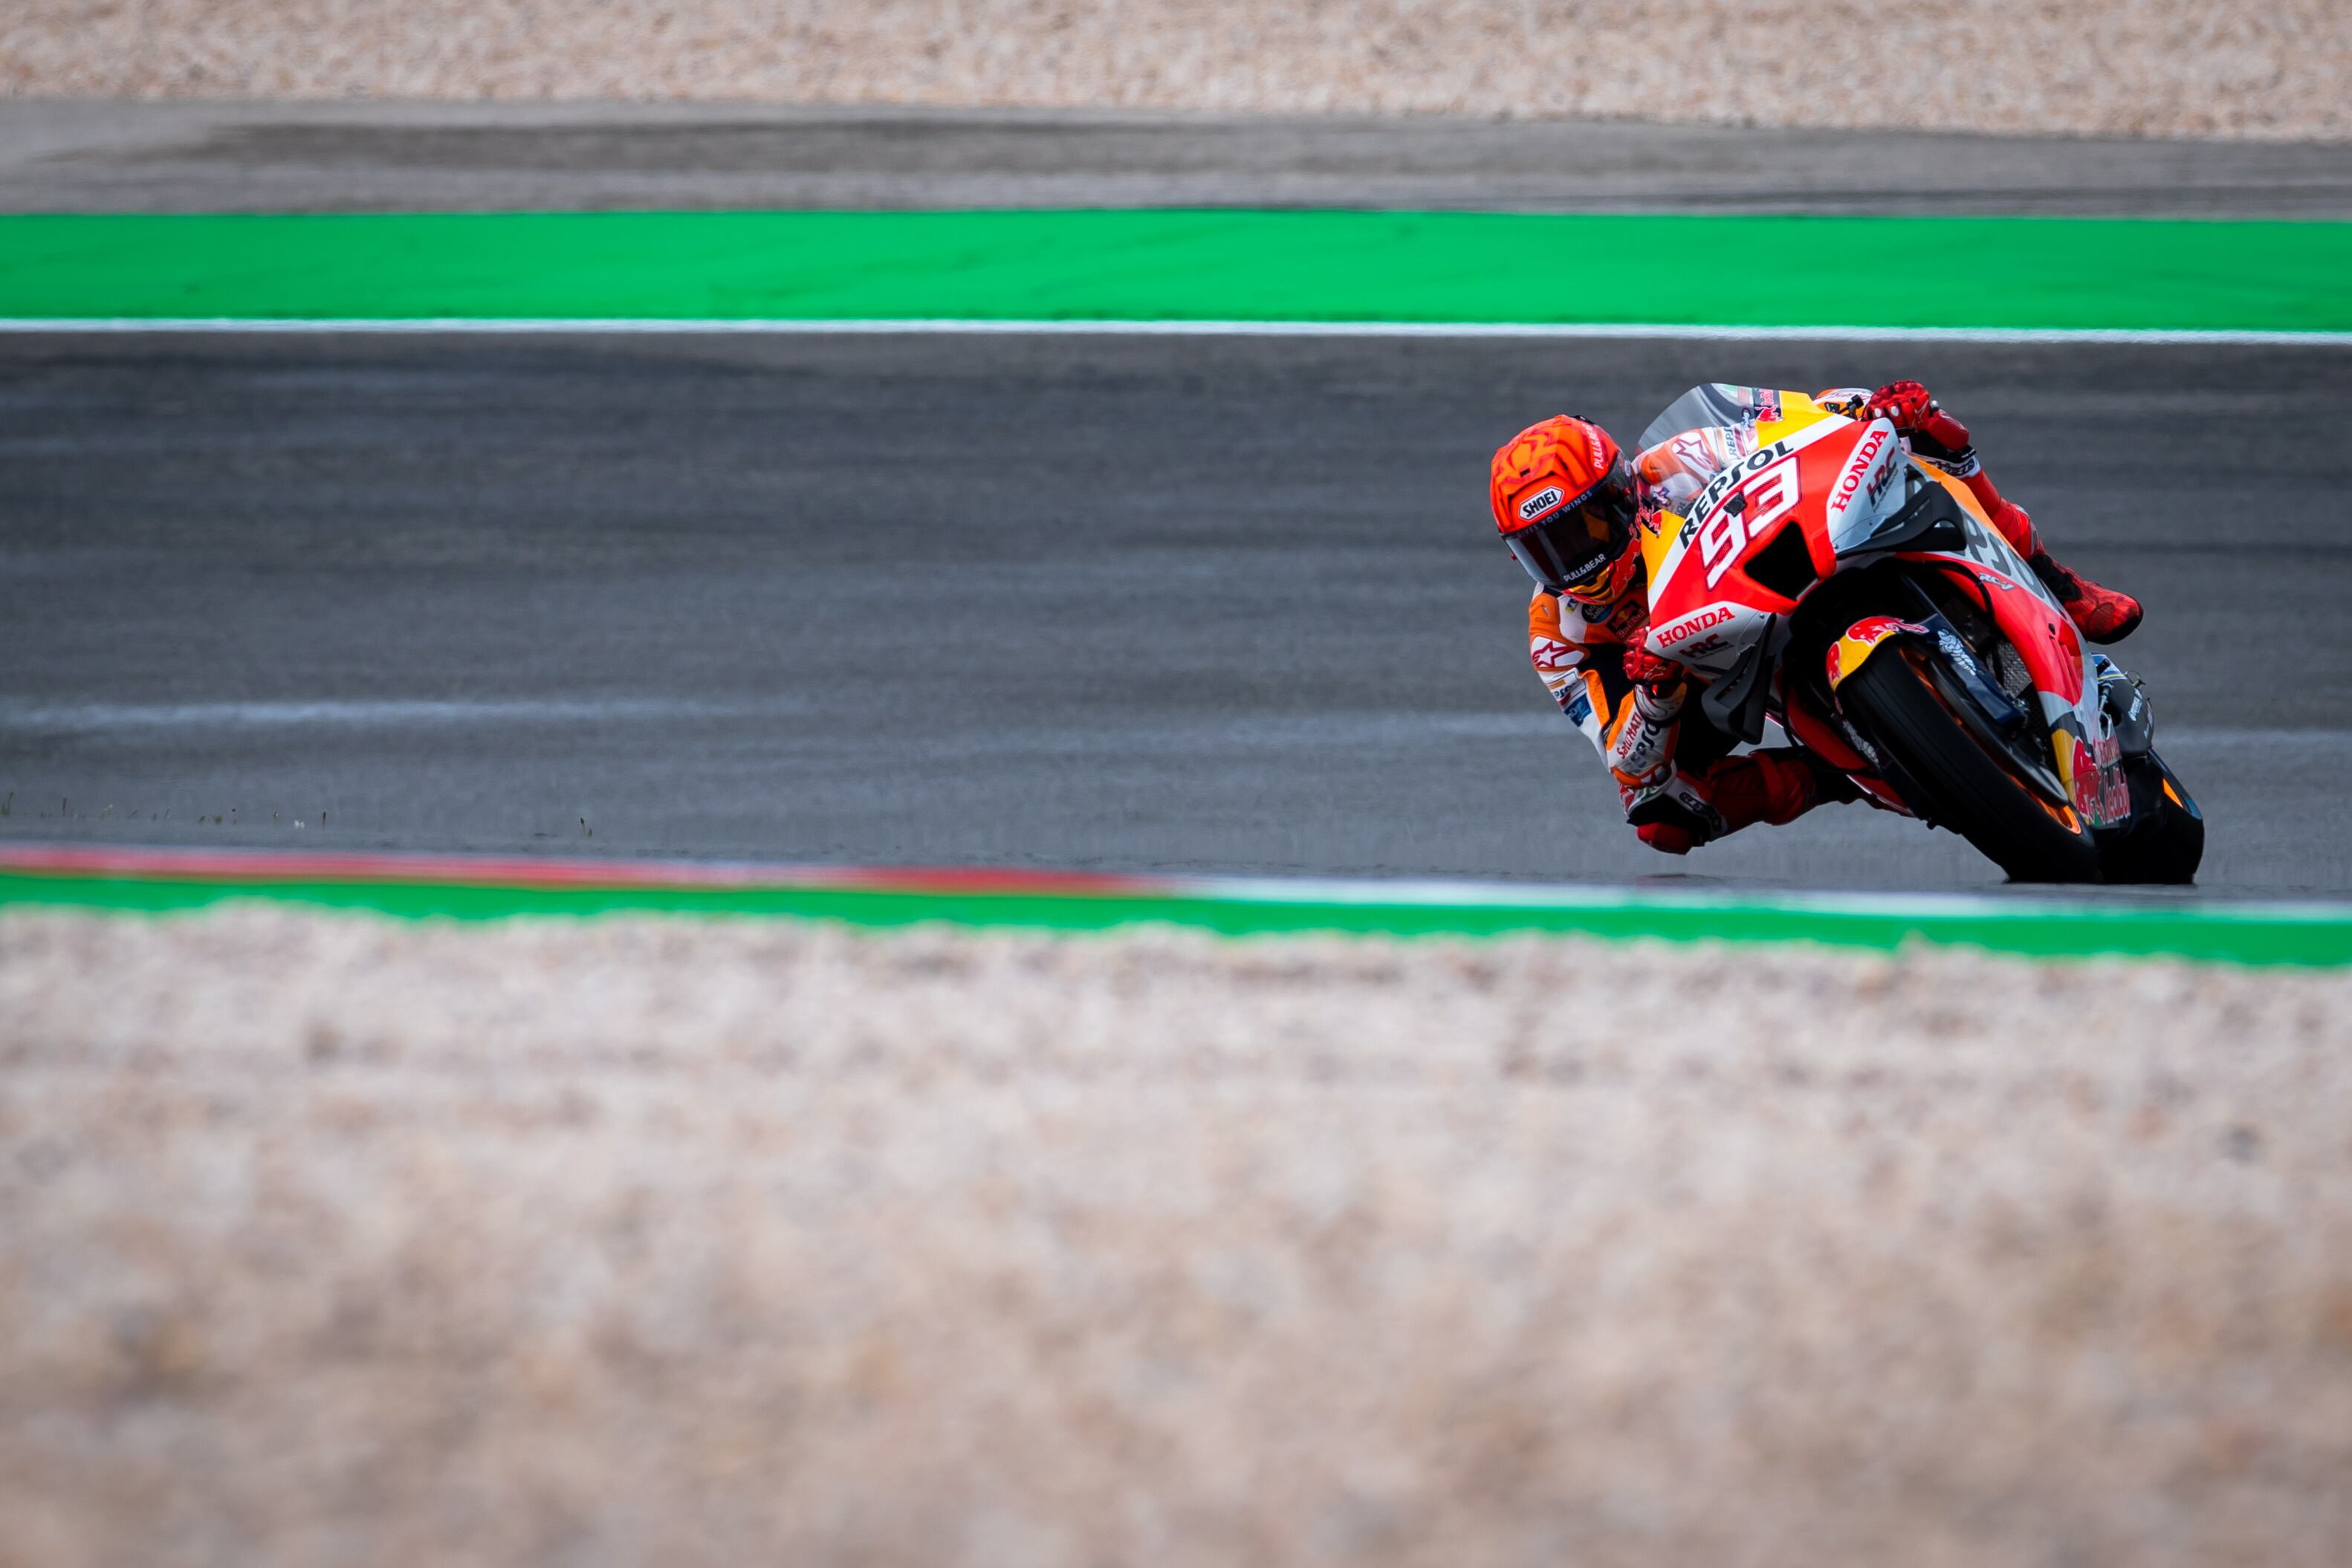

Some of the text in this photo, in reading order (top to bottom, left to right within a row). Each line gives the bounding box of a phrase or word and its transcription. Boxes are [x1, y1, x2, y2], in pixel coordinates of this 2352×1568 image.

[1724, 427, 1737, 456] REPS
[1830, 430, 1888, 512] HONDA
[1866, 446, 1896, 508] HRC
[1522, 490, 1558, 518] SHOEI
[1541, 511, 1560, 526] YOU
[1562, 490, 1593, 513] WINGS
[1679, 441, 1794, 549] REPSOL
[1699, 456, 1801, 591] 93
[1563, 553, 1606, 582] PULL&BEAR
[1656, 606, 1735, 648] HONDA
[1679, 633, 1729, 658] HRC
